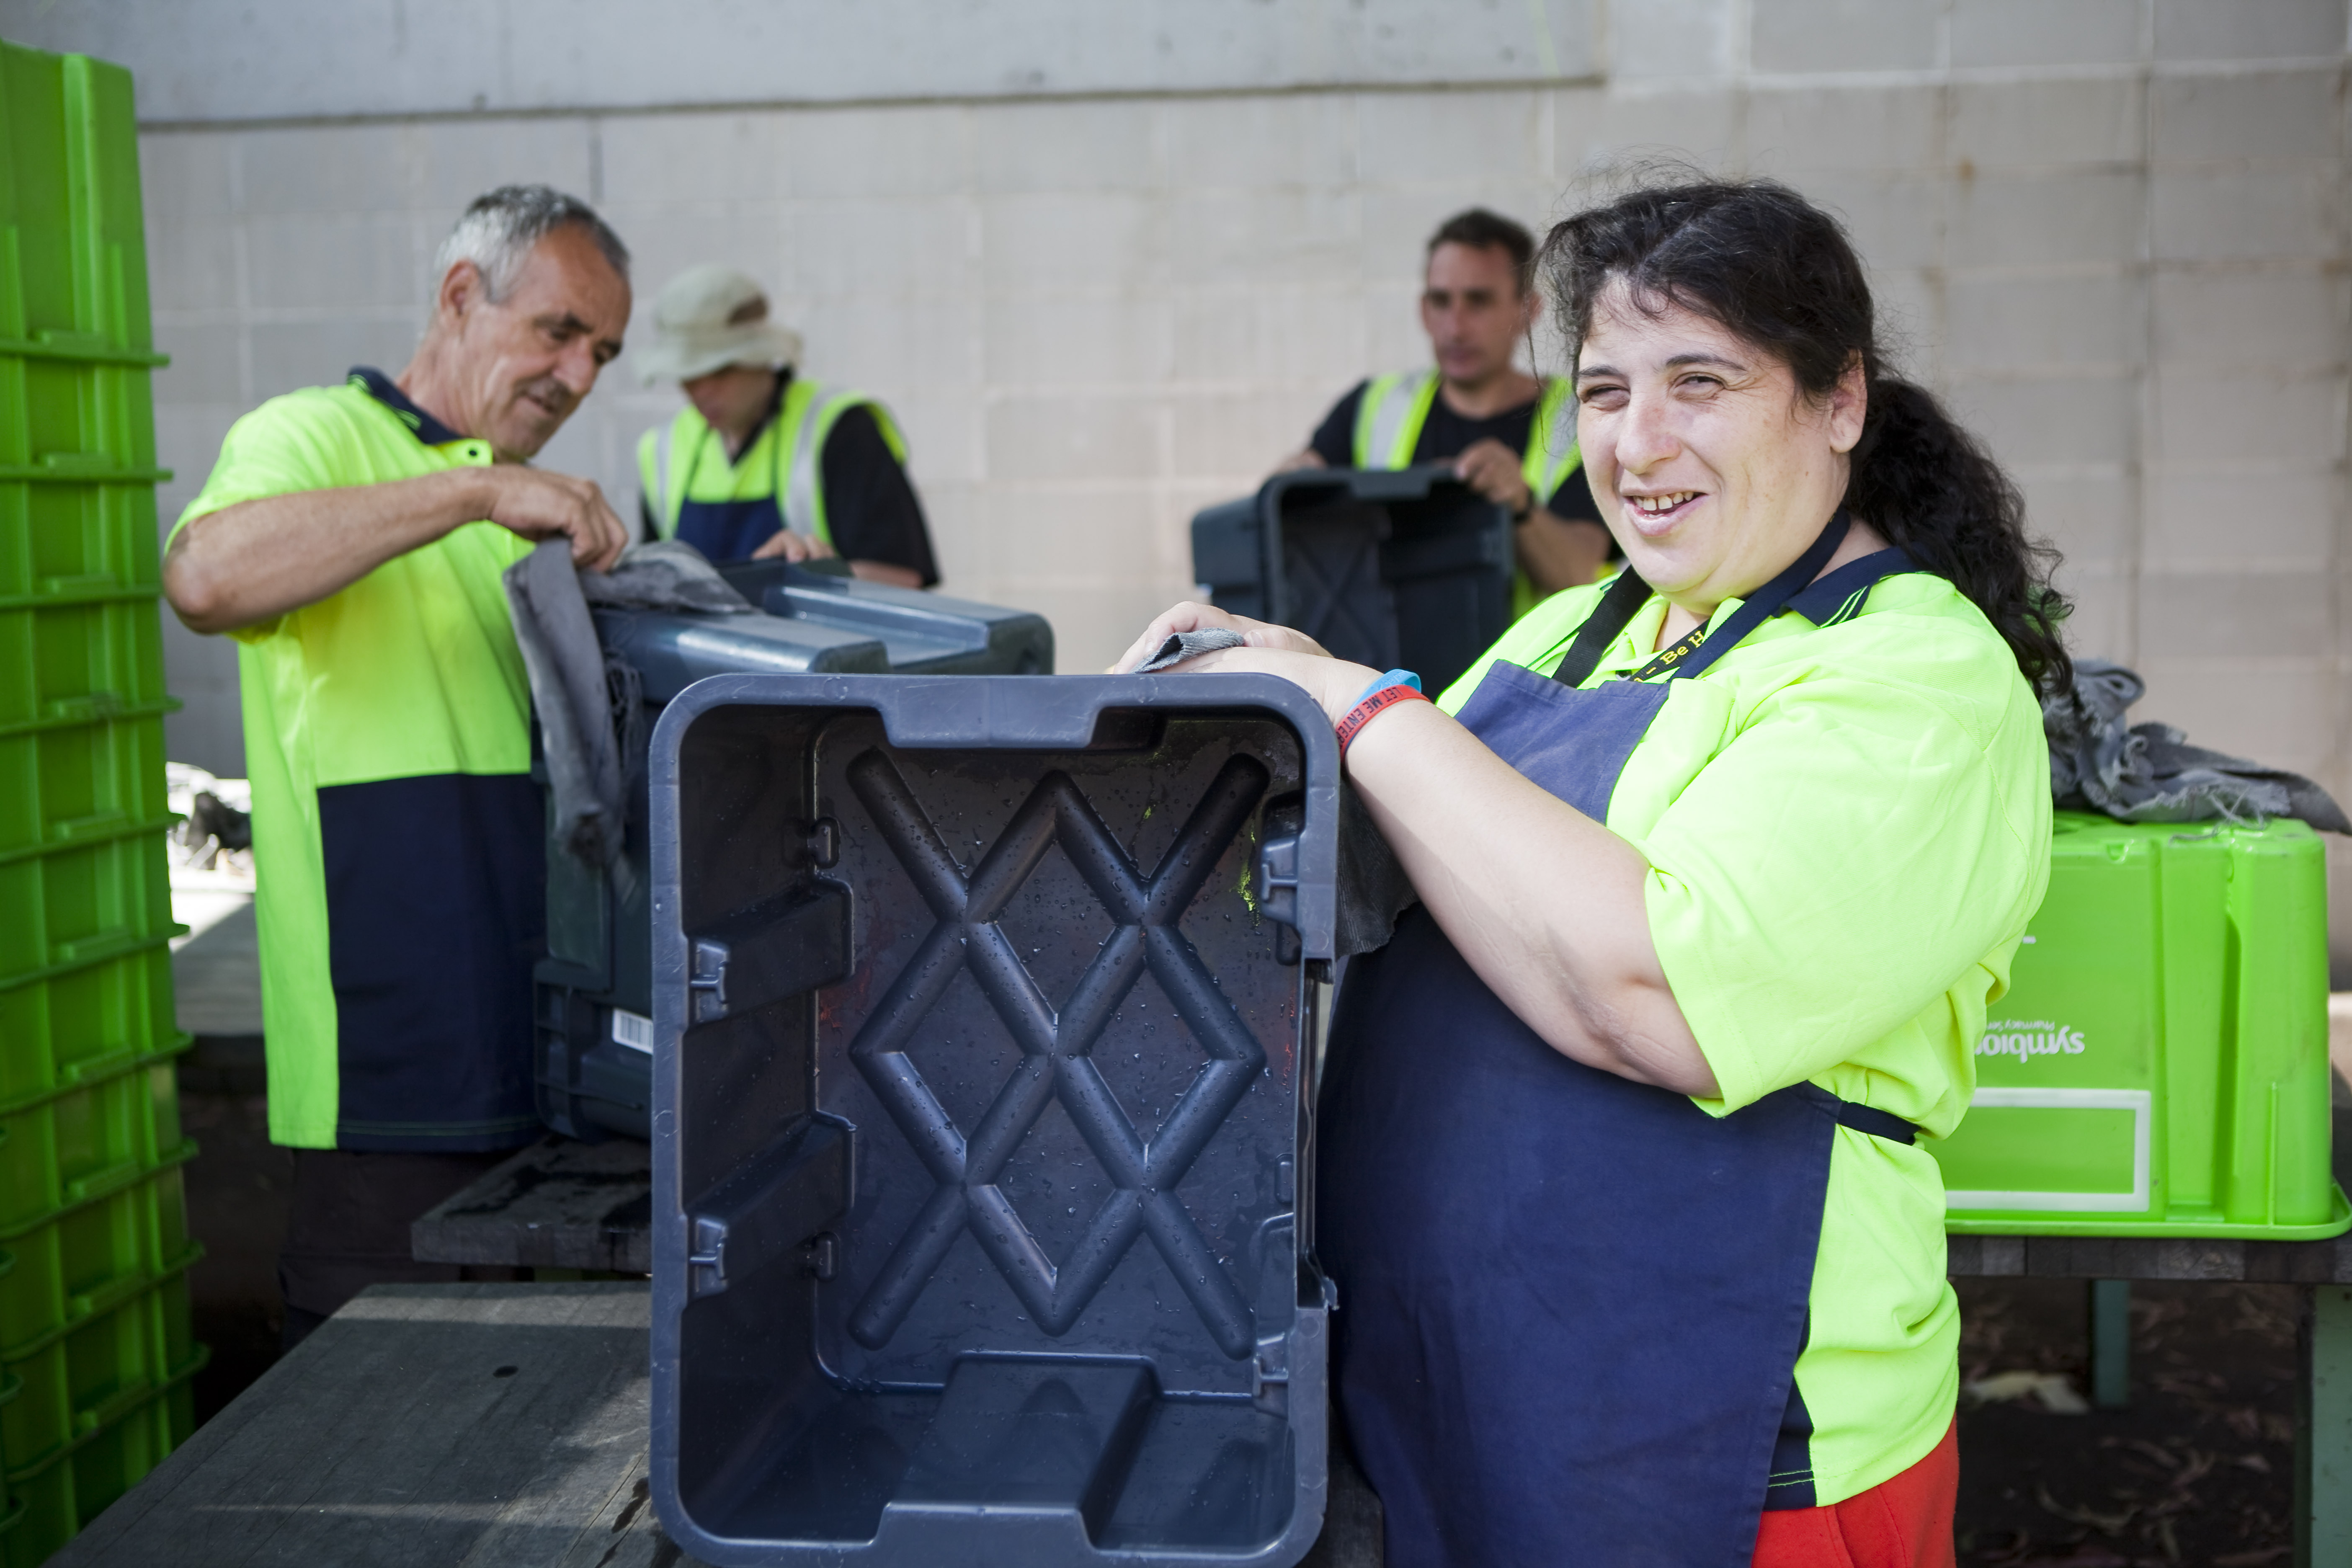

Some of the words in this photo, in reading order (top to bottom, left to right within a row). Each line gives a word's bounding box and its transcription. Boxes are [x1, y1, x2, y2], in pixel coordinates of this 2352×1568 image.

[1659, 646, 1689, 665] Be
[1382, 687, 1403, 702] LET
[1362, 695, 1383, 713] ME
[2004, 1019, 2055, 1032] Pharmacy
